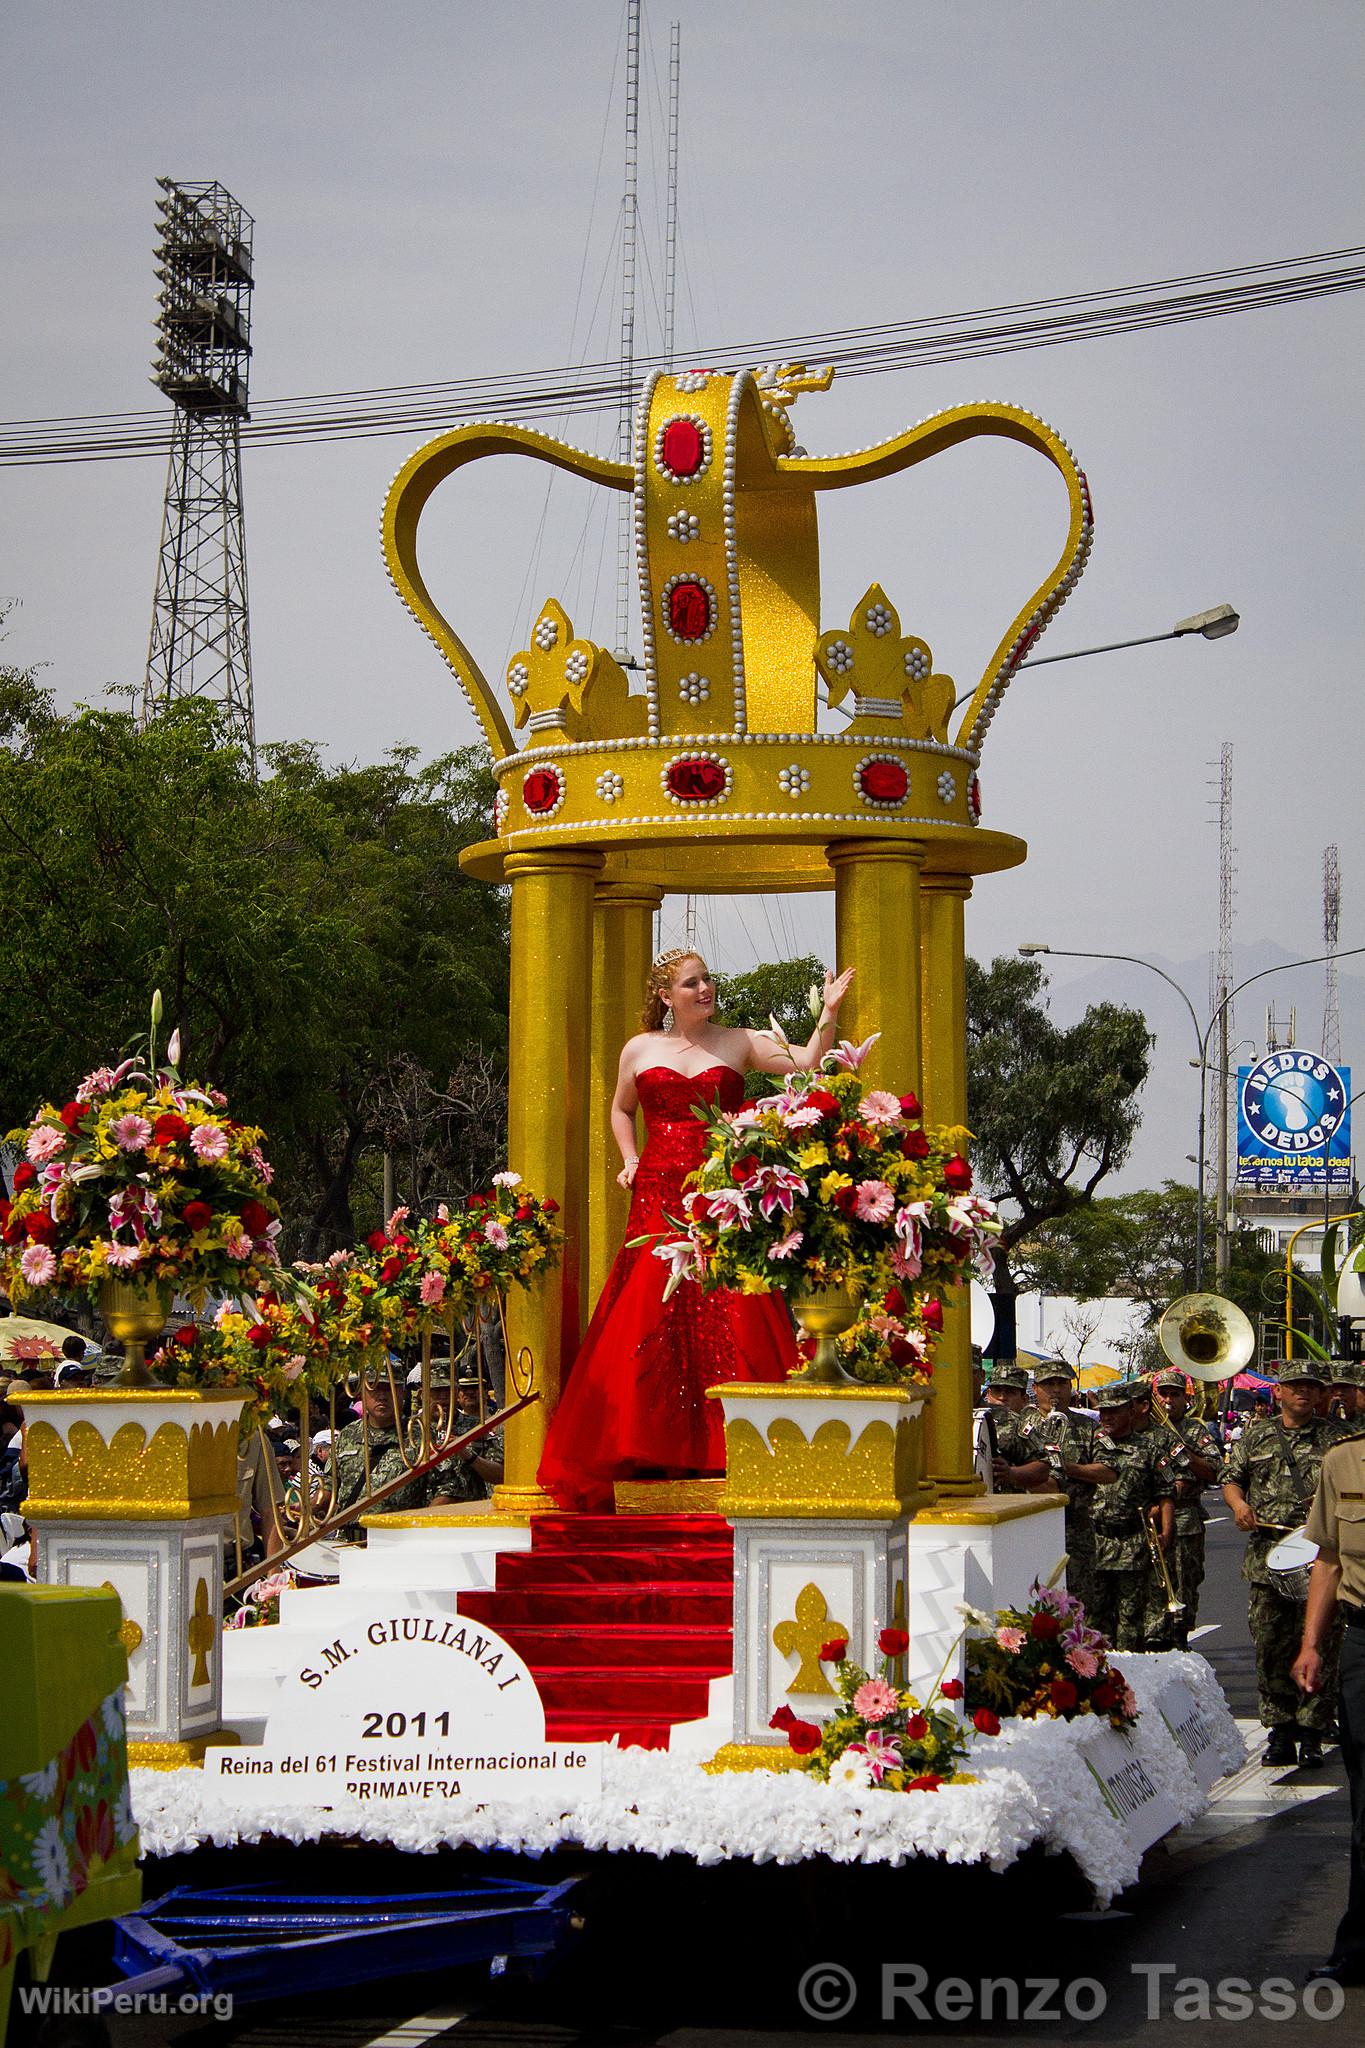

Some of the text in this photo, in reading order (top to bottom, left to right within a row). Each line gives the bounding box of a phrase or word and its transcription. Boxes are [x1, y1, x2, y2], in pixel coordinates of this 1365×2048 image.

[1250, 1054, 1330, 1091] DEDOS
[1261, 1114, 1337, 1148] DEDOS
[1239, 1156, 1283, 1166] teemos
[1284, 1155, 1296, 1166] tu
[1297, 1154, 1324, 1167] taba
[300, 1618, 520, 1691] S.M. GIULIANA I
[362, 1711, 450, 1738] 2011
[1175, 1710, 1211, 1761] movist
[220, 1751, 587, 1775] Reina del 61 Festival Internacional de
[346, 1781, 461, 1799] PRIMAVERA
[1107, 1759, 1158, 1816] movistar
